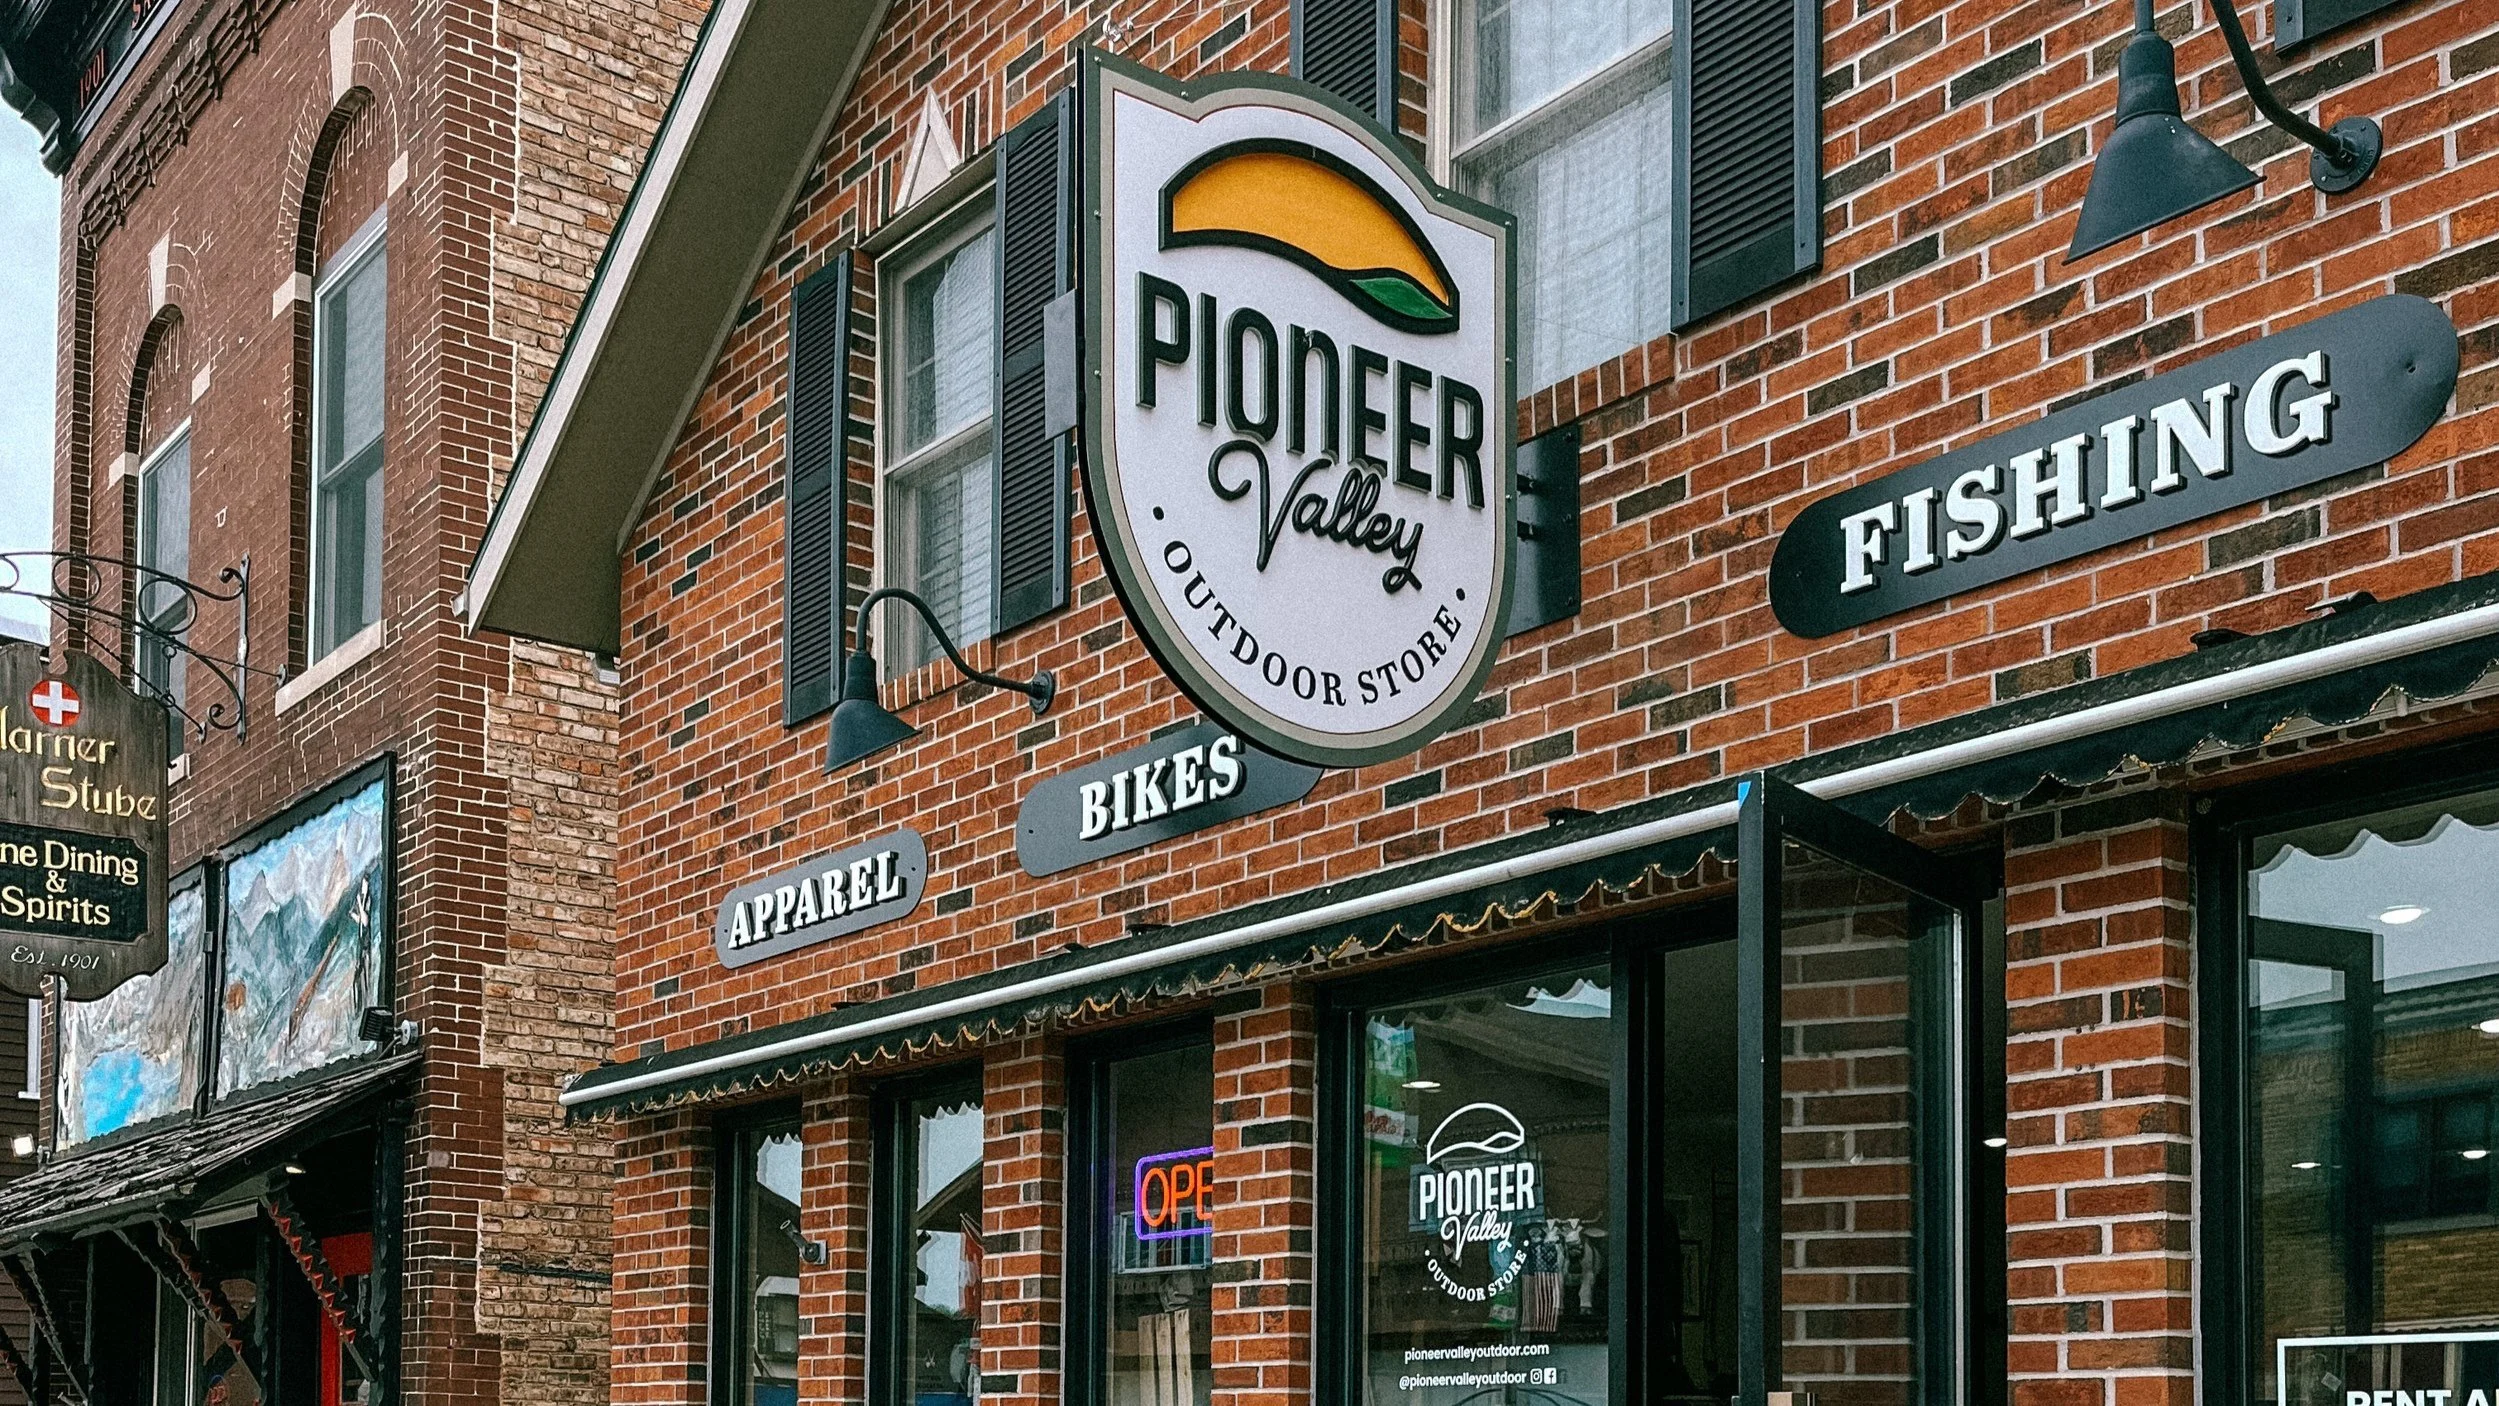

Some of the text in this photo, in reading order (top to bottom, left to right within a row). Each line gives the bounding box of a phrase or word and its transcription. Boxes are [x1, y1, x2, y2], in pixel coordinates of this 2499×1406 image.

[80, 47, 105, 110] 1901
[1135, 271, 1485, 508] PIONEER
[1839, 349, 2336, 595] FISHING
[1208, 439, 1424, 595] Valley
[1164, 540, 1462, 707] OUTDOOR STORE
[40, 766, 157, 821] Stube
[1079, 734, 1244, 841] BIKES
[43, 840, 139, 886] Dining
[45, 870, 67, 894] &
[0, 886, 111, 926] Spirits
[727, 850, 905, 949] APPAREL
[61, 953, 100, 970] 1901
[1141, 1160, 1214, 1227] OPE
[1419, 1161, 1536, 1221] PIONEER
[1440, 1210, 1513, 1261] Valley
[1427, 1249, 1527, 1302] OUTDOOR STORE
[1399, 1371, 1527, 1391] @pioneervalleyoutdoor
[1404, 1343, 1550, 1365] pioneervalleyoutdoor.com
